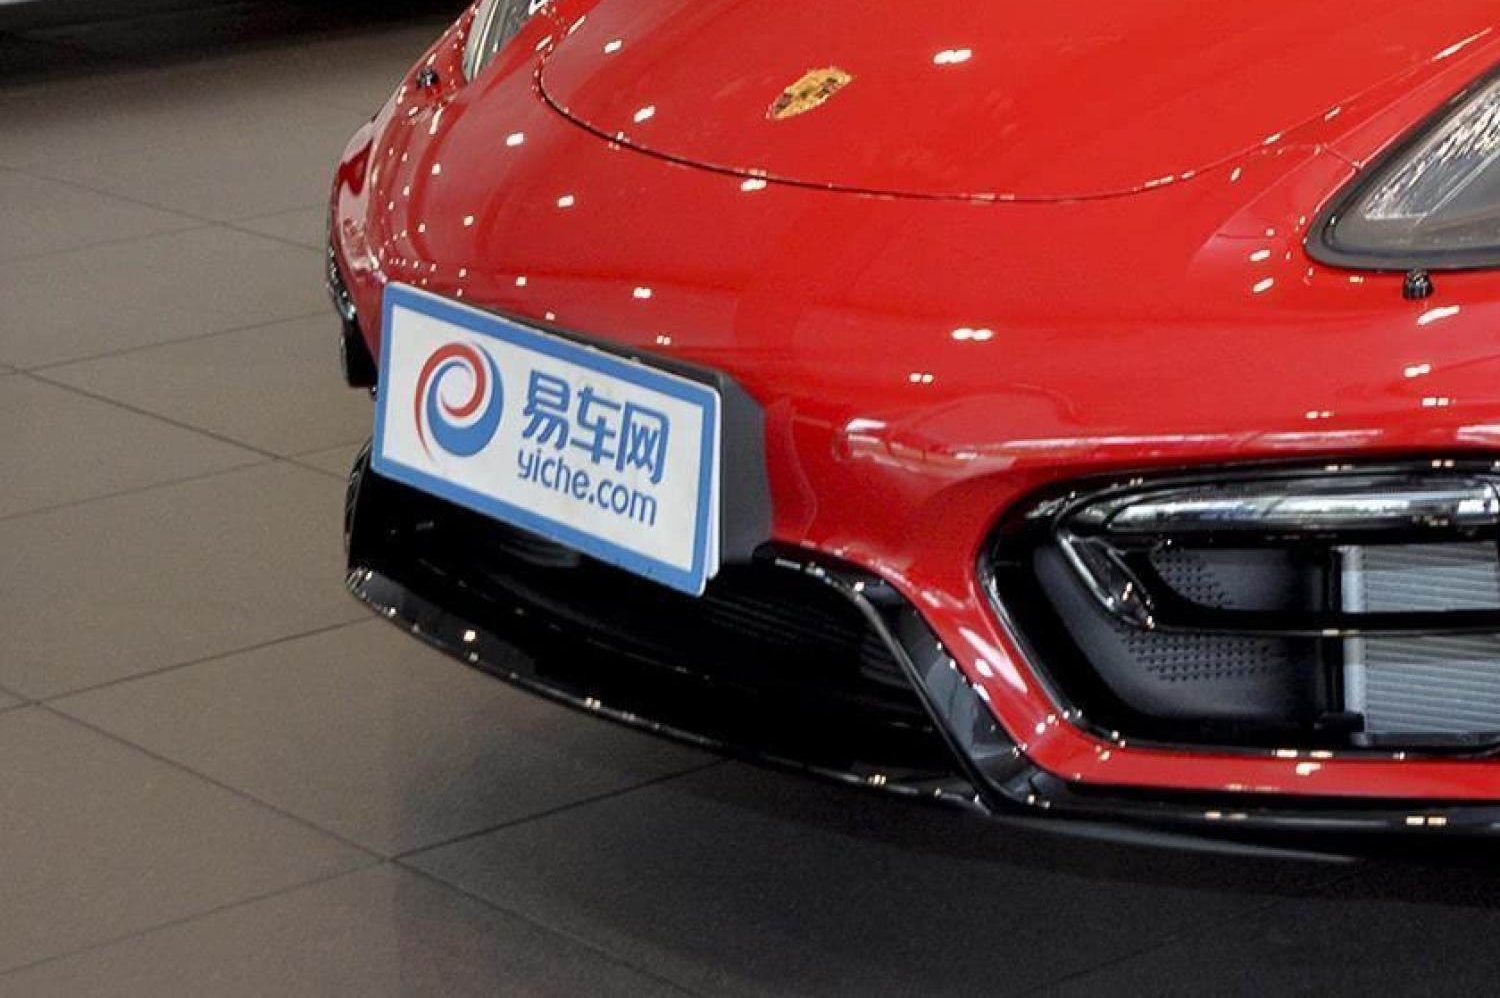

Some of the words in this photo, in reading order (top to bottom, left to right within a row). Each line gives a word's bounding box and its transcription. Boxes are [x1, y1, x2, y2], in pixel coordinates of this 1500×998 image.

[522, 370, 669, 485] 易车网
[517, 449, 658, 527] yiche.com
